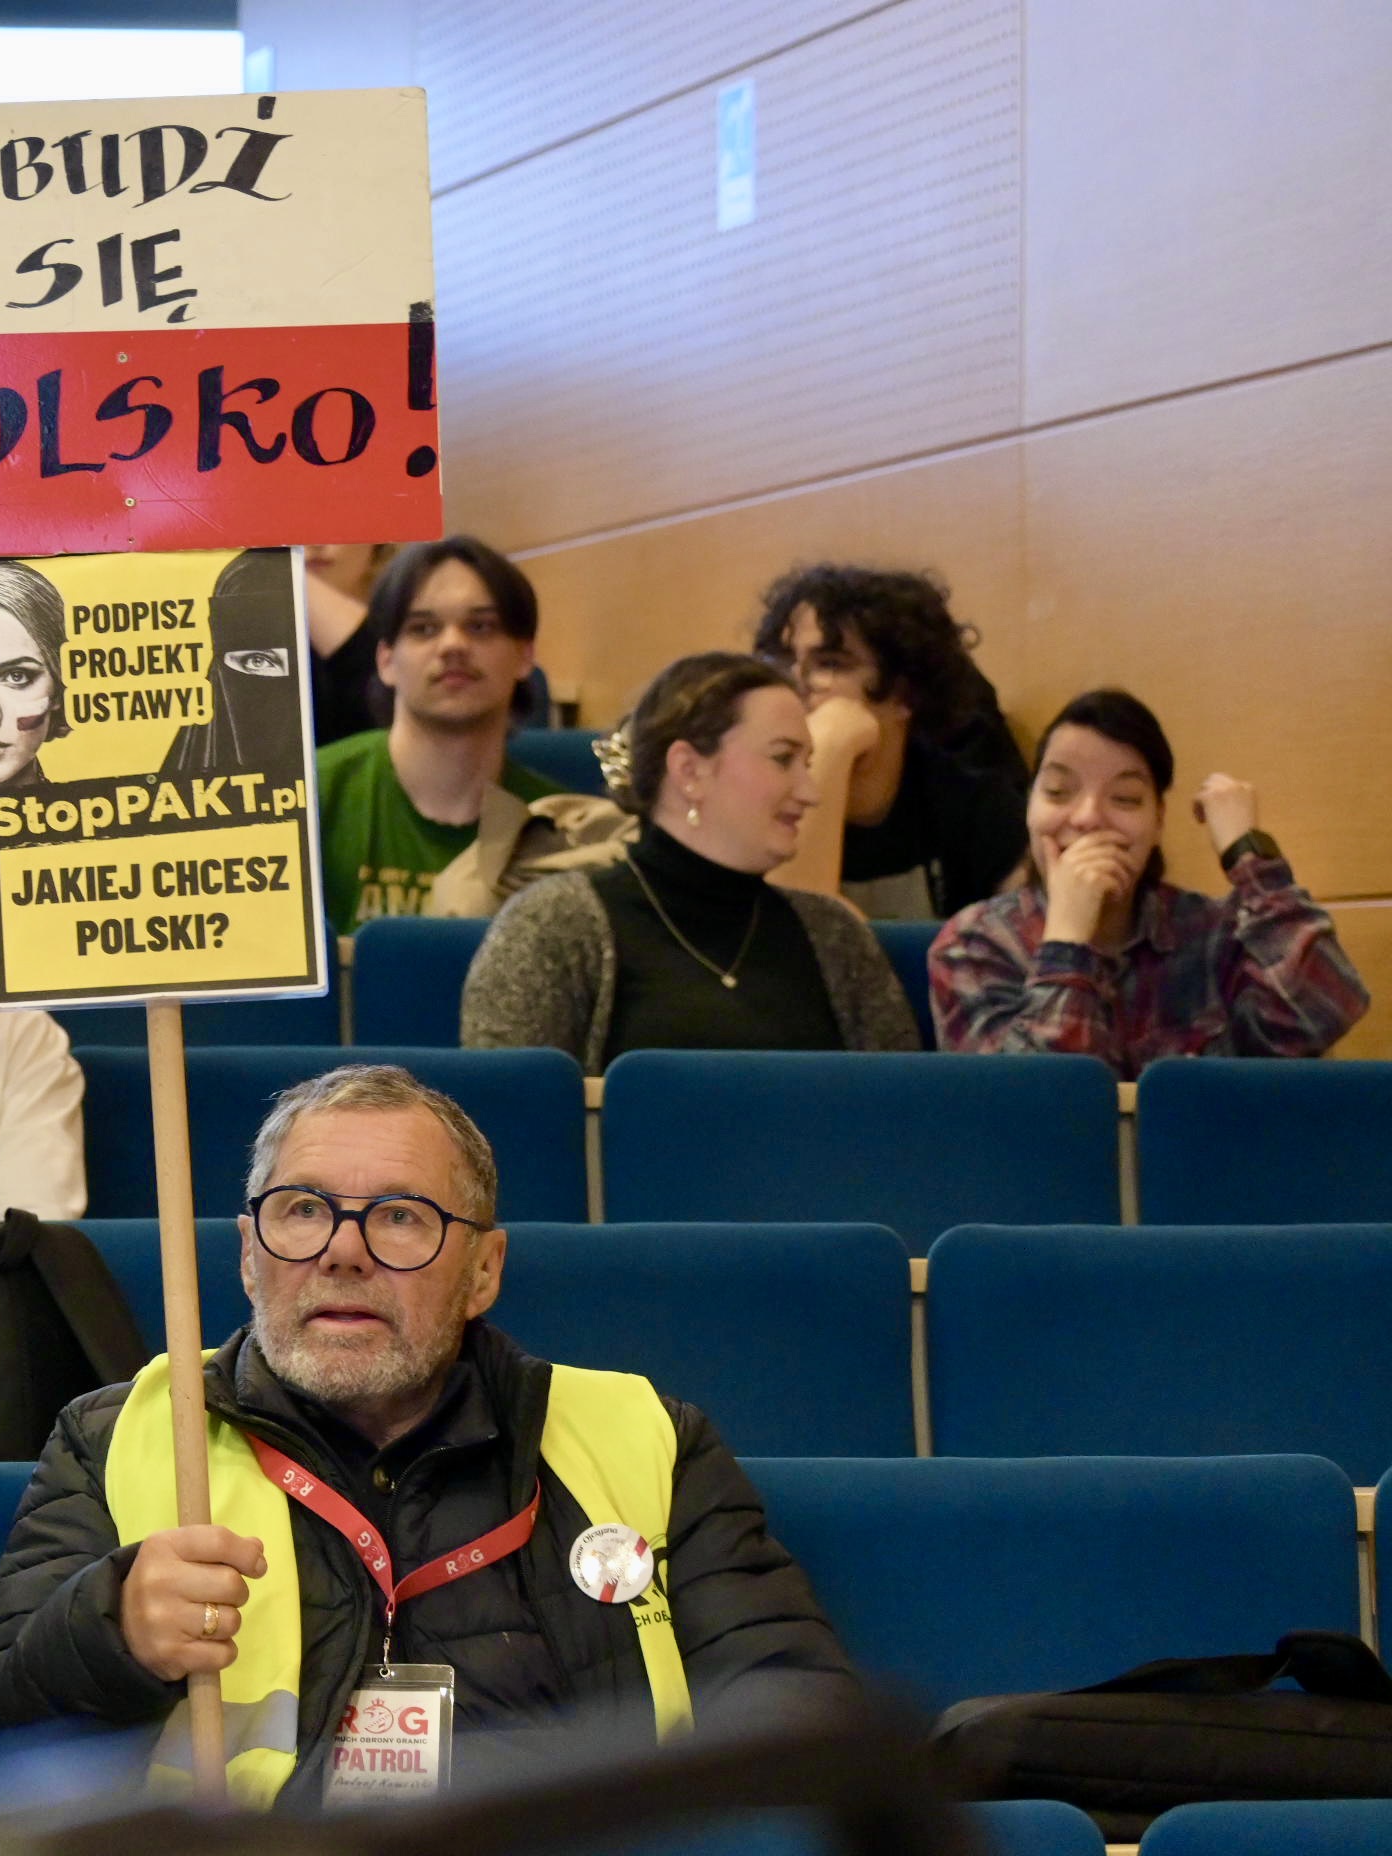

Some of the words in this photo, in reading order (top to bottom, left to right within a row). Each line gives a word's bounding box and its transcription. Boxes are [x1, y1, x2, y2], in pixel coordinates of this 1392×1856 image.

[6, 228, 198, 324] SIĘ
[72, 598, 196, 635] PODPISZ
[68, 642, 204, 680] PROJEKT
[72, 686, 207, 724] USTAWY!
[11, 862, 142, 907] JAKIEJ
[152, 854, 290, 898] CHCESZ
[76, 912, 230, 957] POLSKI?
[333, 1747, 427, 1774] PATROL
